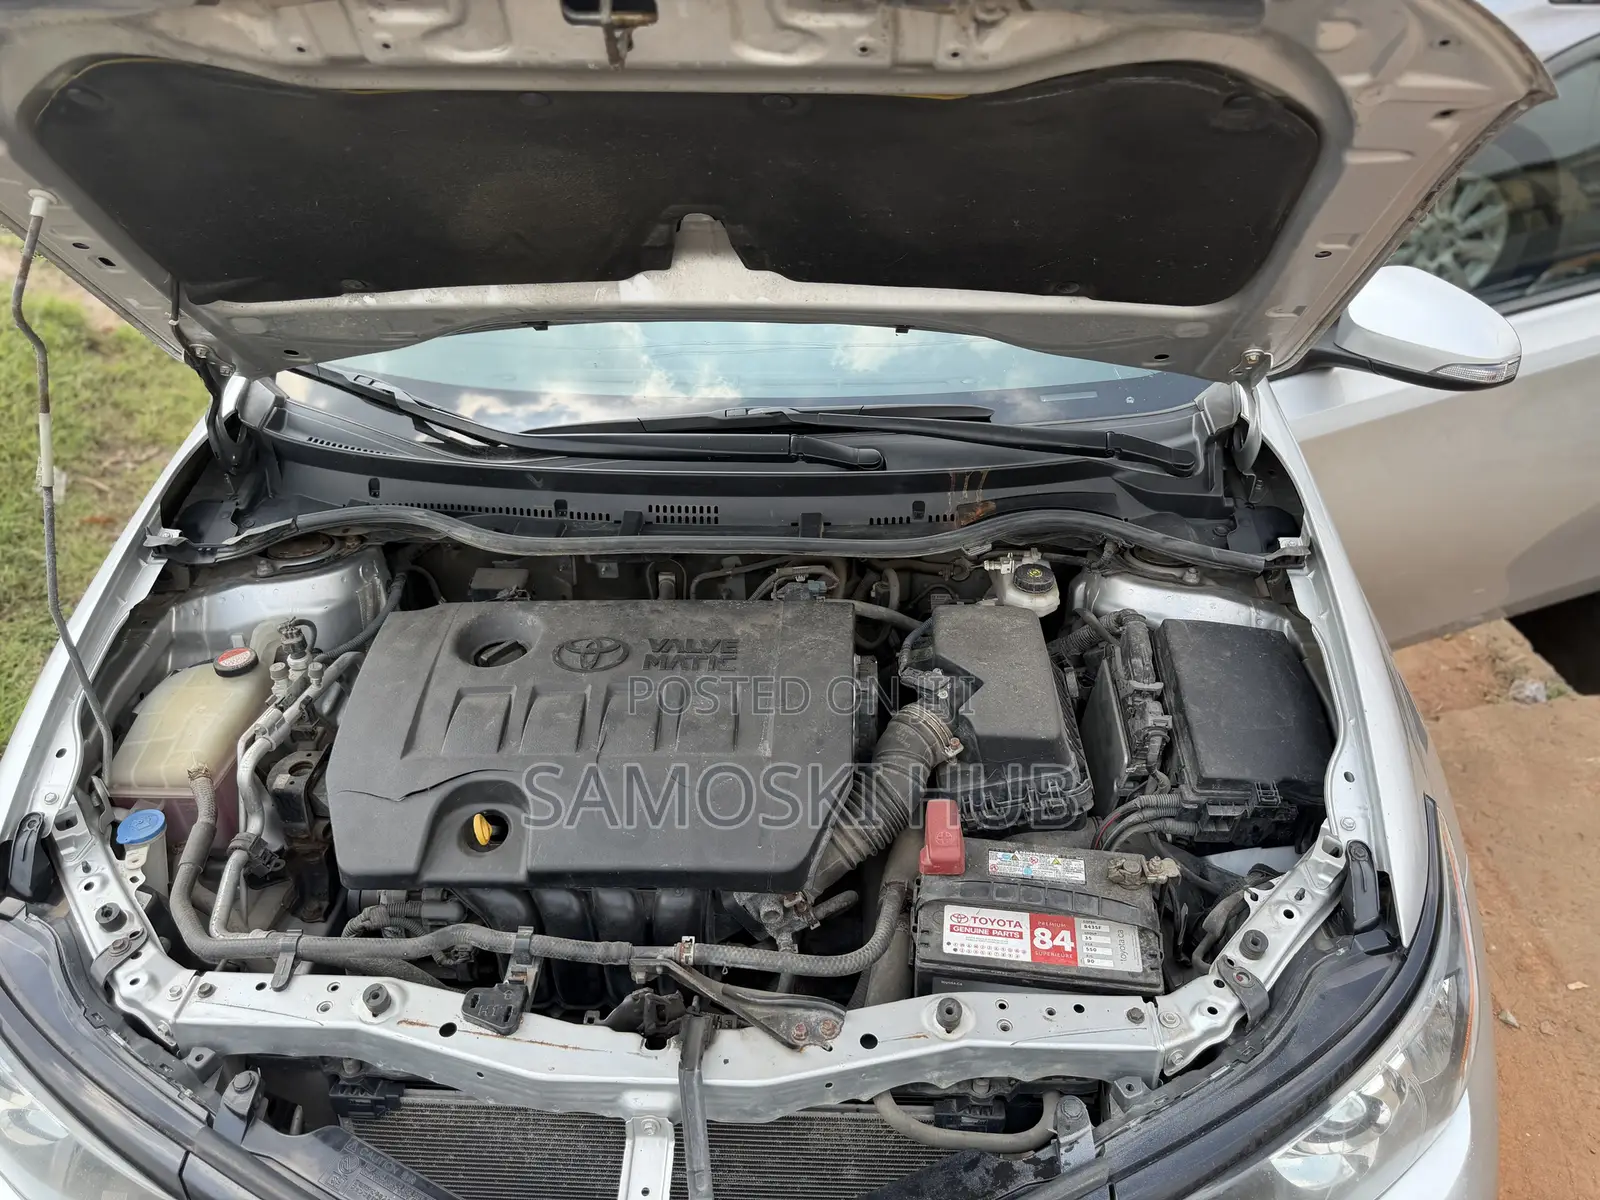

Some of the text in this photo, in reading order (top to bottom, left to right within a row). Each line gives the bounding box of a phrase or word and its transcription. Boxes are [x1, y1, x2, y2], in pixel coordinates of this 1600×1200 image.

[647, 638, 739, 653] VALVE
[642, 653, 738, 671] MATIC
[971, 916, 1023, 929] TOYOTA
[953, 925, 1020, 938] GENUINE PARTS
[1033, 927, 1075, 952] 84
[359, 1147, 400, 1184] CAUTION
